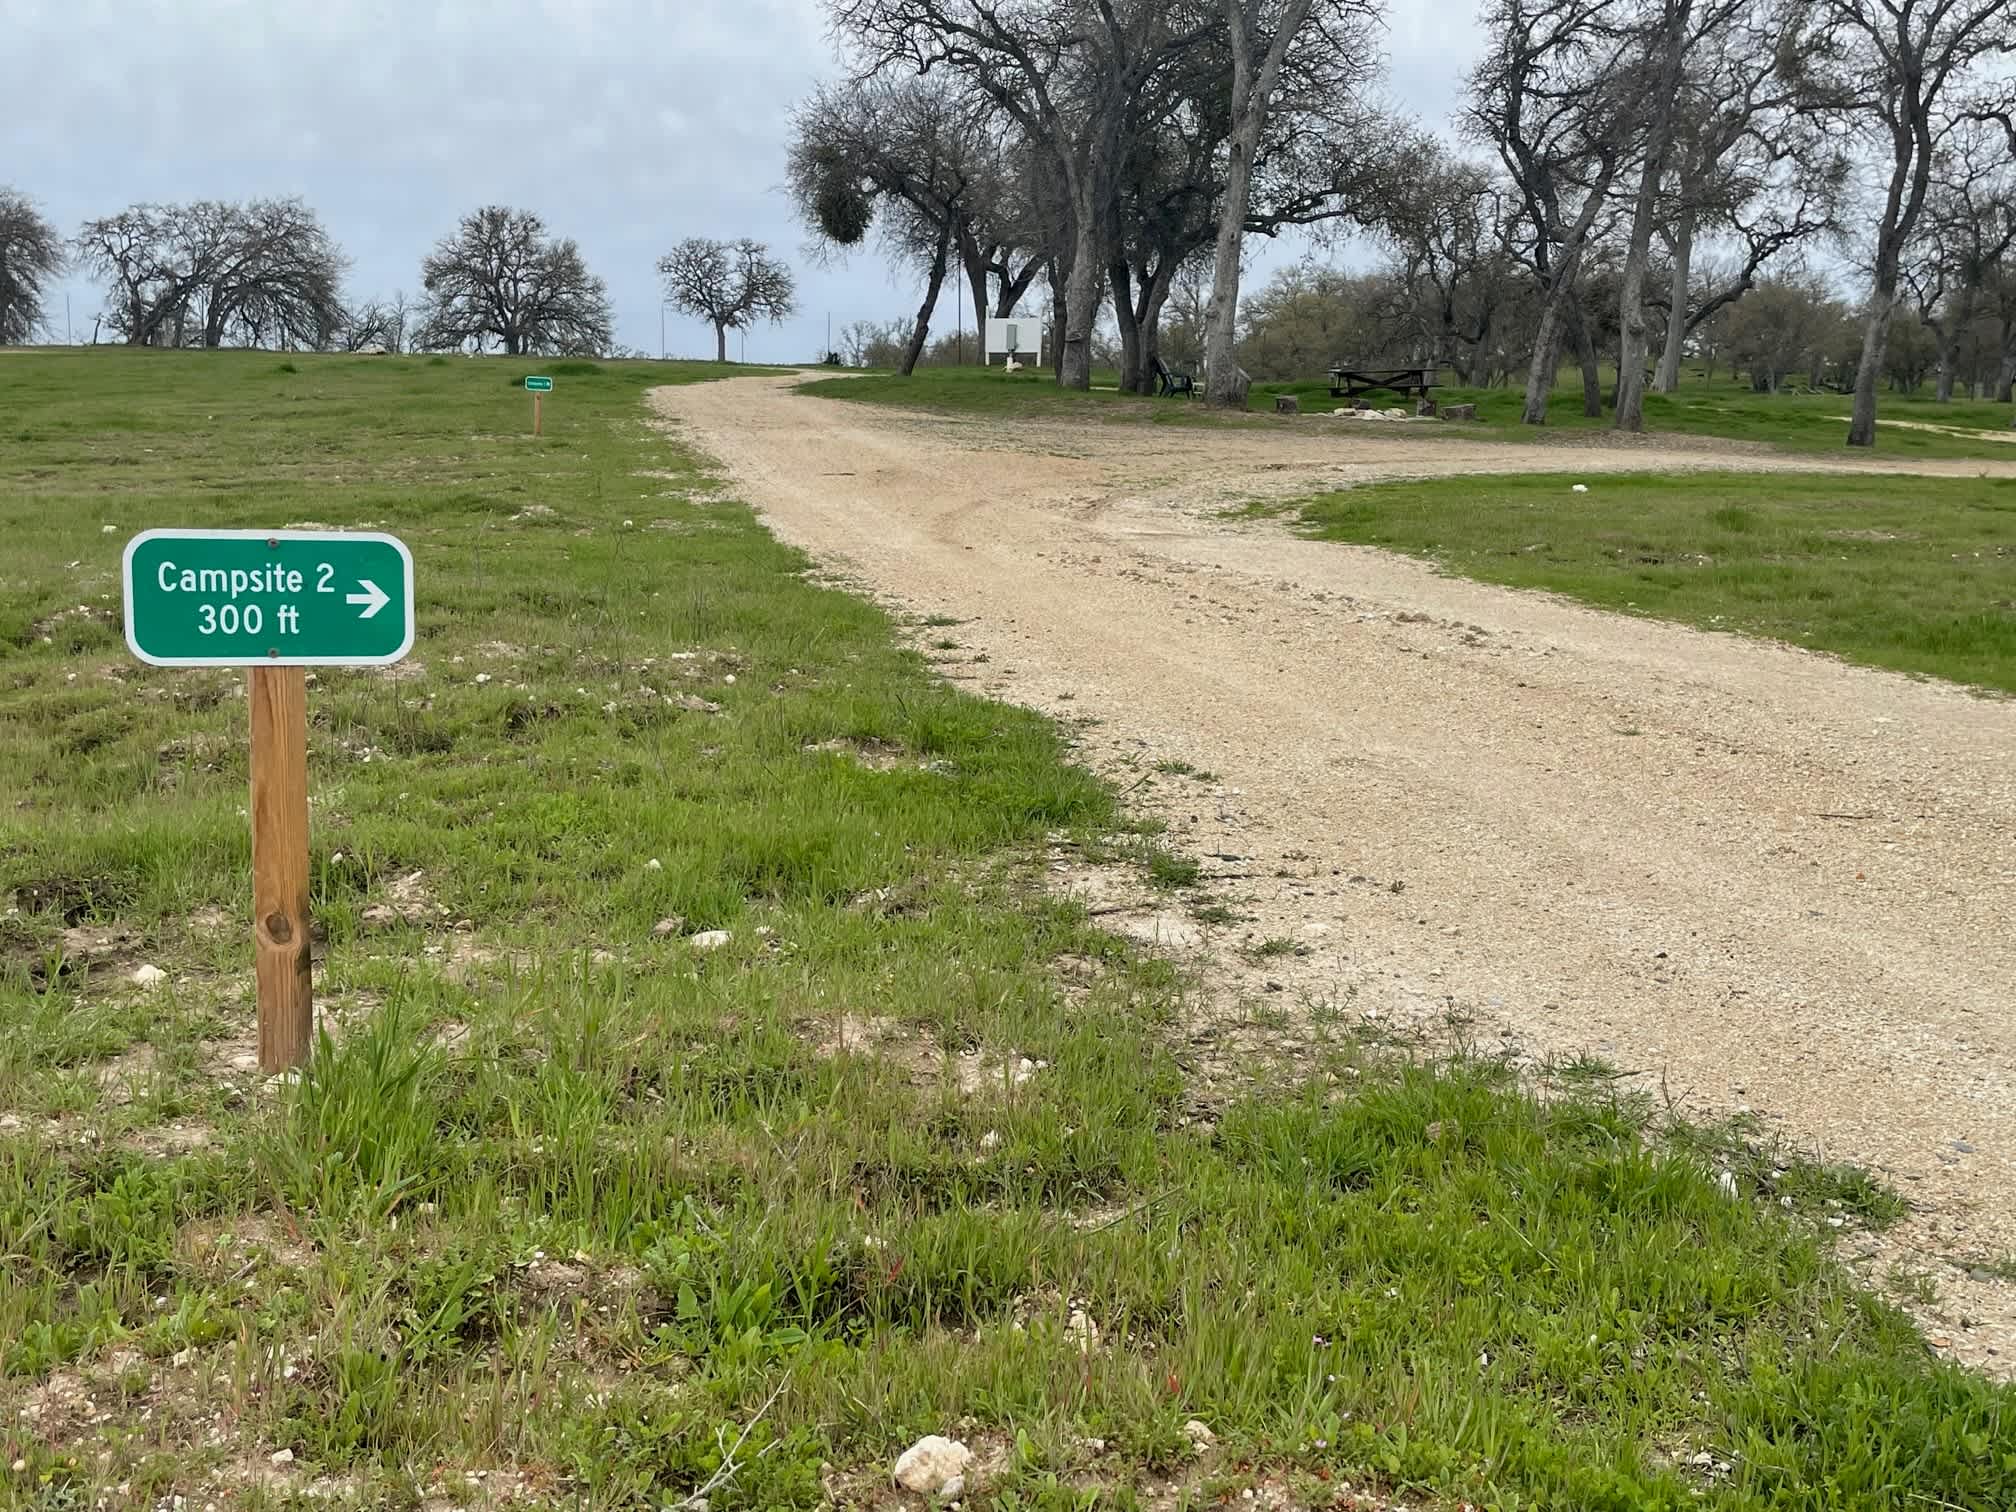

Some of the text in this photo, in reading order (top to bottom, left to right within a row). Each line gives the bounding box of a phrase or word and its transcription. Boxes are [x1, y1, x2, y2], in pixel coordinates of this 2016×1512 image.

[158, 561, 335, 599] Campsite 2
[198, 604, 300, 635] 300 ft
